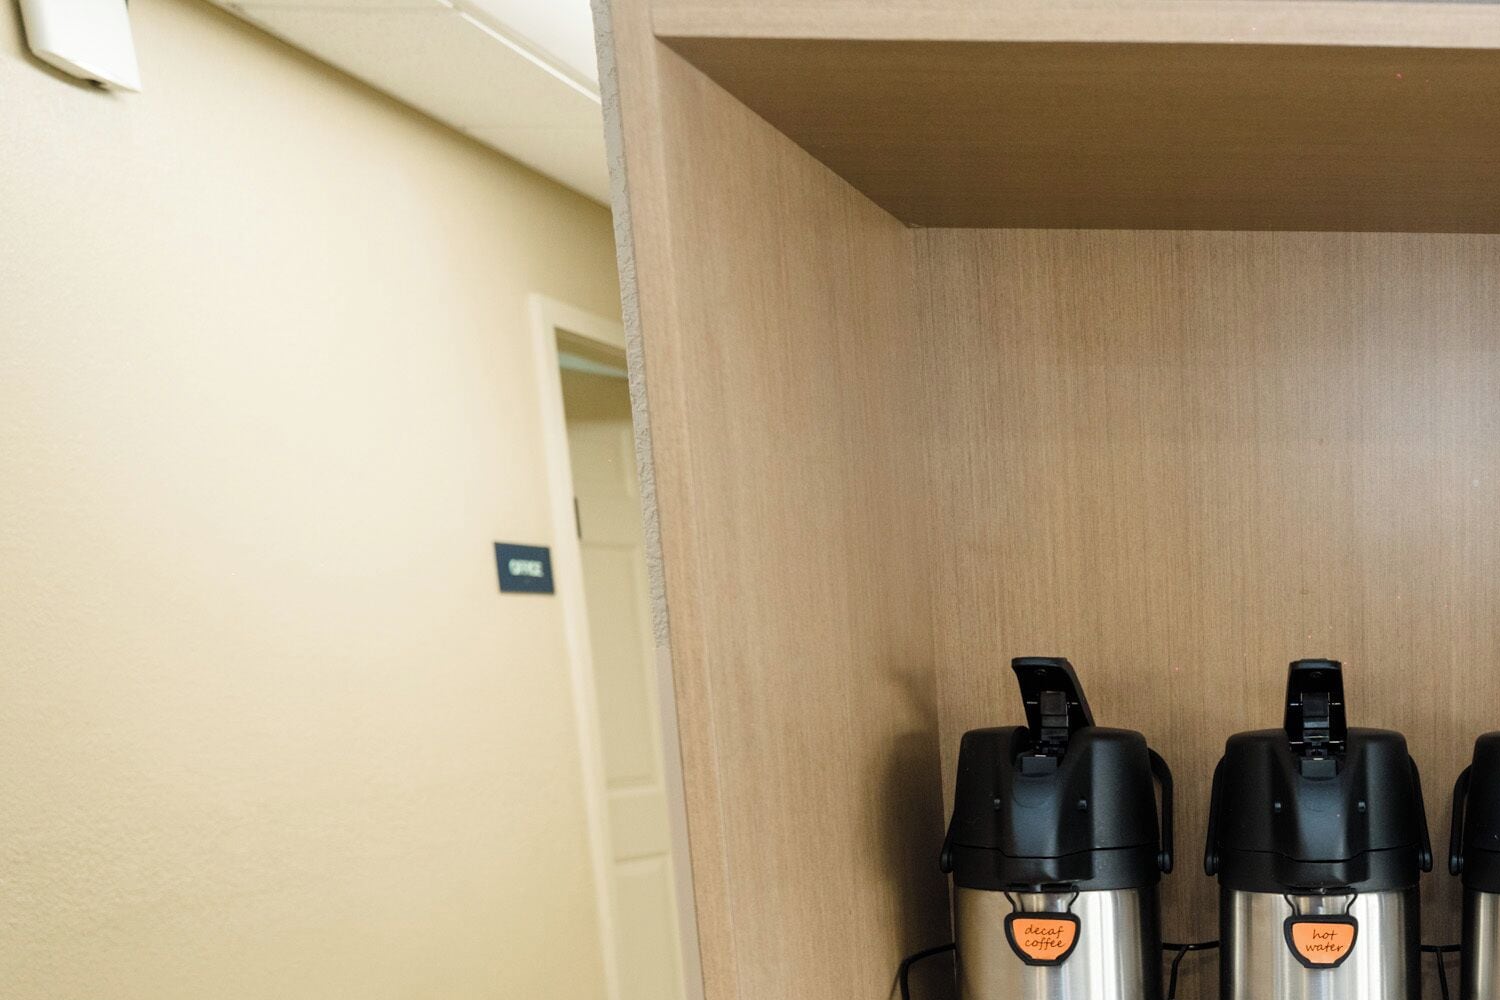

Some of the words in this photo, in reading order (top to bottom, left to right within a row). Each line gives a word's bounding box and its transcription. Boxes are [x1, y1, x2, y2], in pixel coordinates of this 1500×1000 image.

[1024, 924, 1064, 939] decaf
[1312, 929, 1337, 940] hot
[1024, 938, 1065, 950] coffee
[1305, 942, 1344, 952] water
